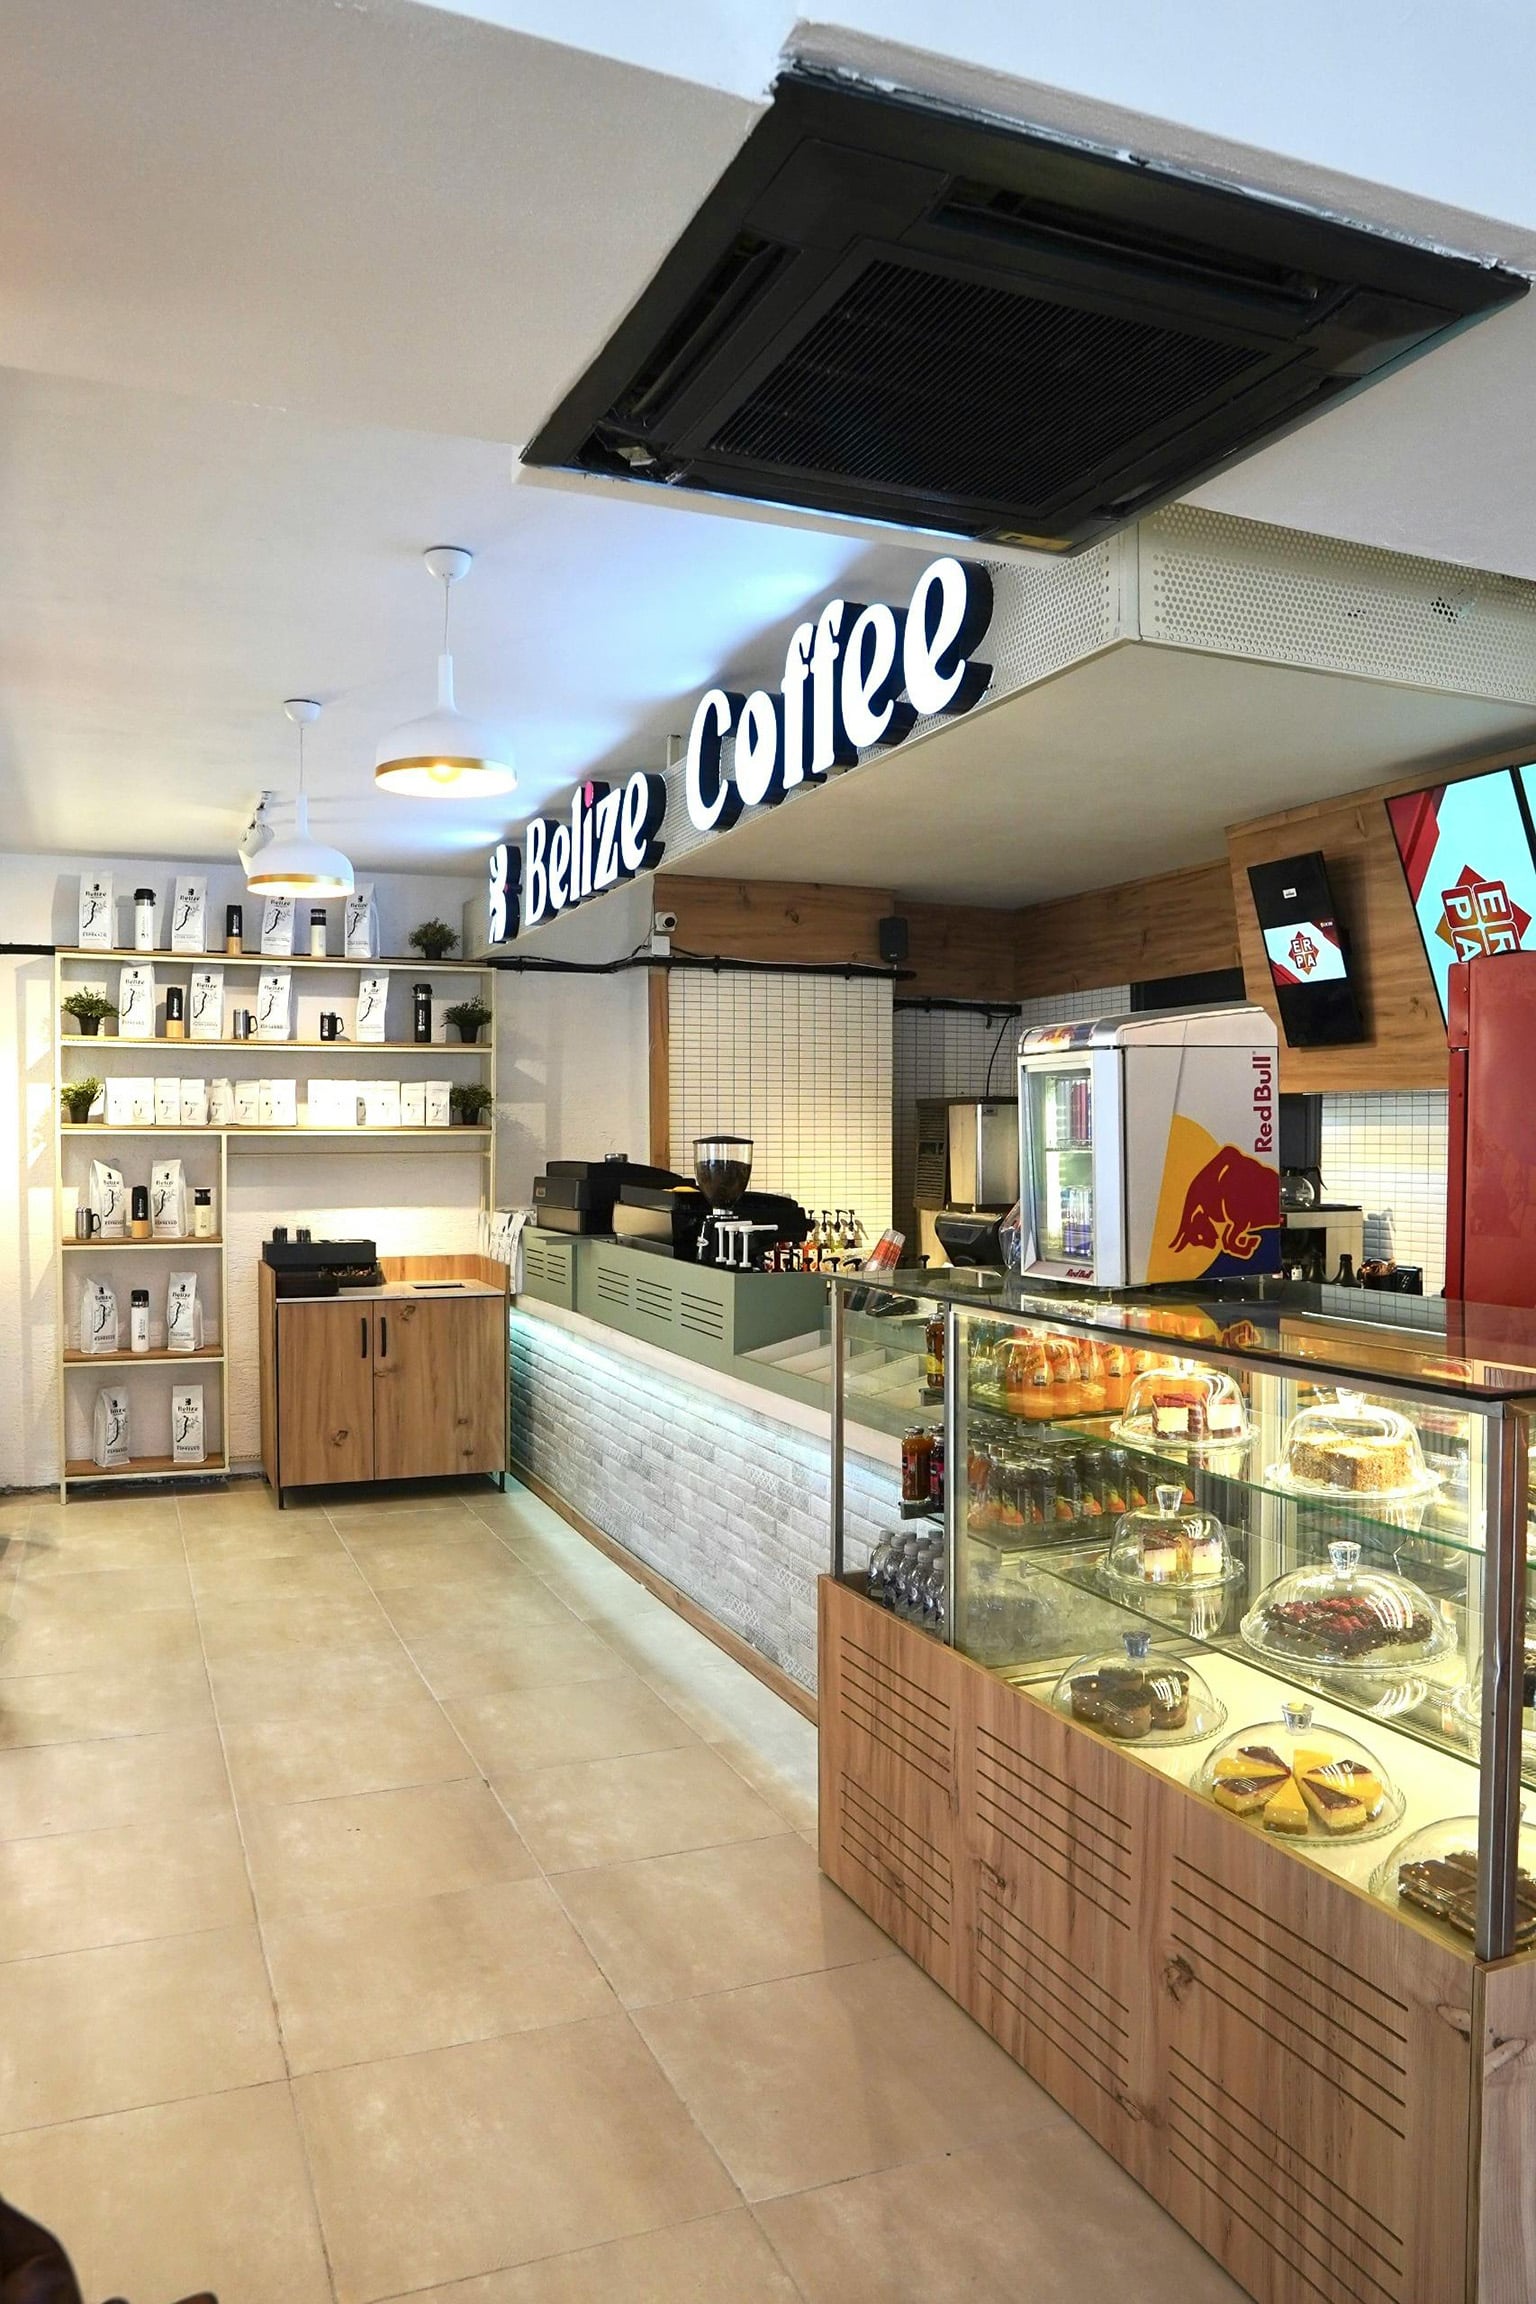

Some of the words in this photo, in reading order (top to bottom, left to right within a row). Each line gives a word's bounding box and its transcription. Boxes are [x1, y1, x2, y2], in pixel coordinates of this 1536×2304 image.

[525, 771, 660, 927] Belize
[686, 556, 986, 832] Coffee
[1252, 1056, 1272, 1101] Bull
[1253, 1105, 1272, 1153] Red
